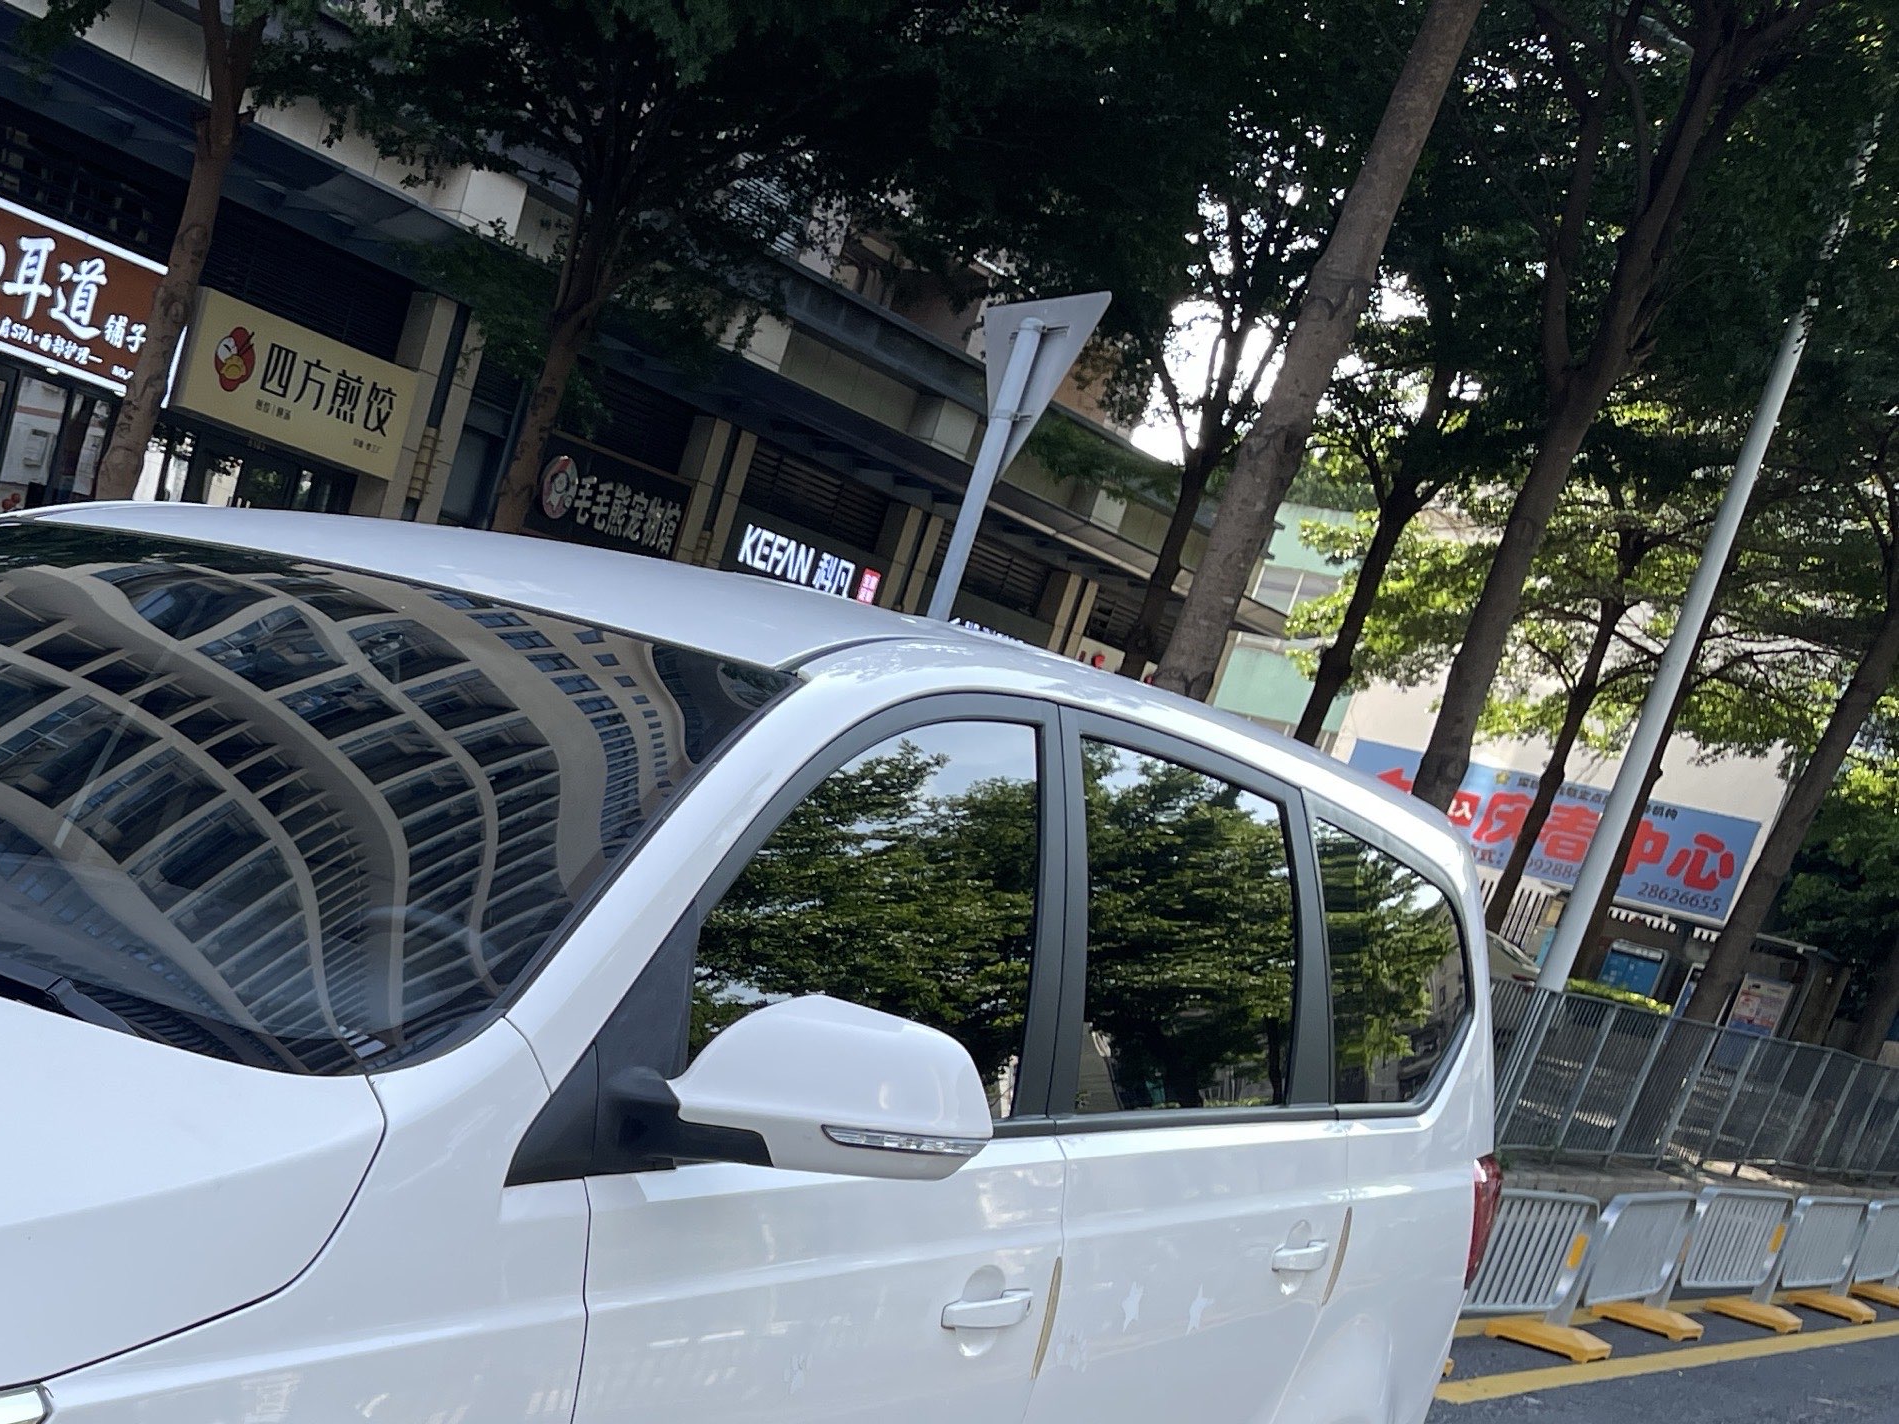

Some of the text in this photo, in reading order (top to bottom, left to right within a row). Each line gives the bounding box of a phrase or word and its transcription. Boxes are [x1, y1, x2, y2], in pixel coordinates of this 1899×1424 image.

[261, 343, 397, 437] 四方煎饺
[574, 476, 682, 555] 毛毛熊宠物馆
[738, 523, 816, 584] KEFAN
[1637, 881, 1723, 914] 28626655
